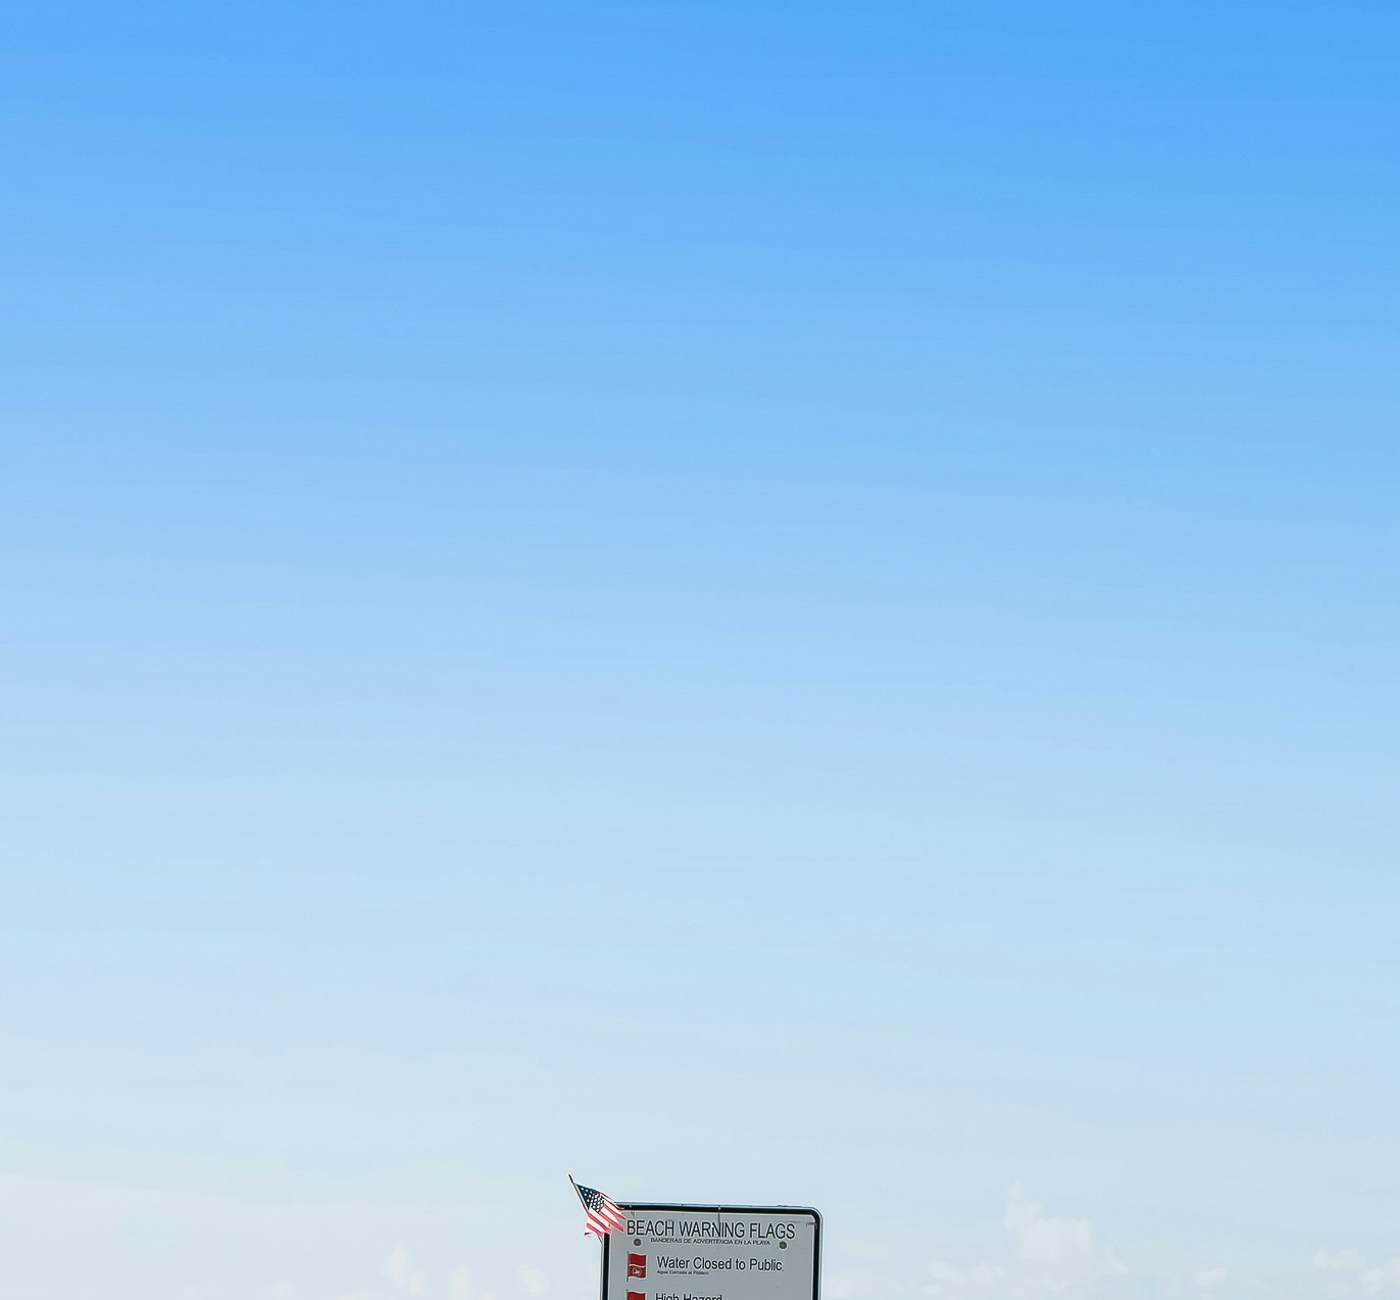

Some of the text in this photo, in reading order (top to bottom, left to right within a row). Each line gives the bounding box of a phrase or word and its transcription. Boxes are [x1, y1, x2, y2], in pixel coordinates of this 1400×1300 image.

[626, 1220, 796, 1239] BEACH WARNING FLAGS
[657, 1256, 690, 1269] Water
[693, 1257, 732, 1270] Closed
[736, 1258, 746, 1270] to
